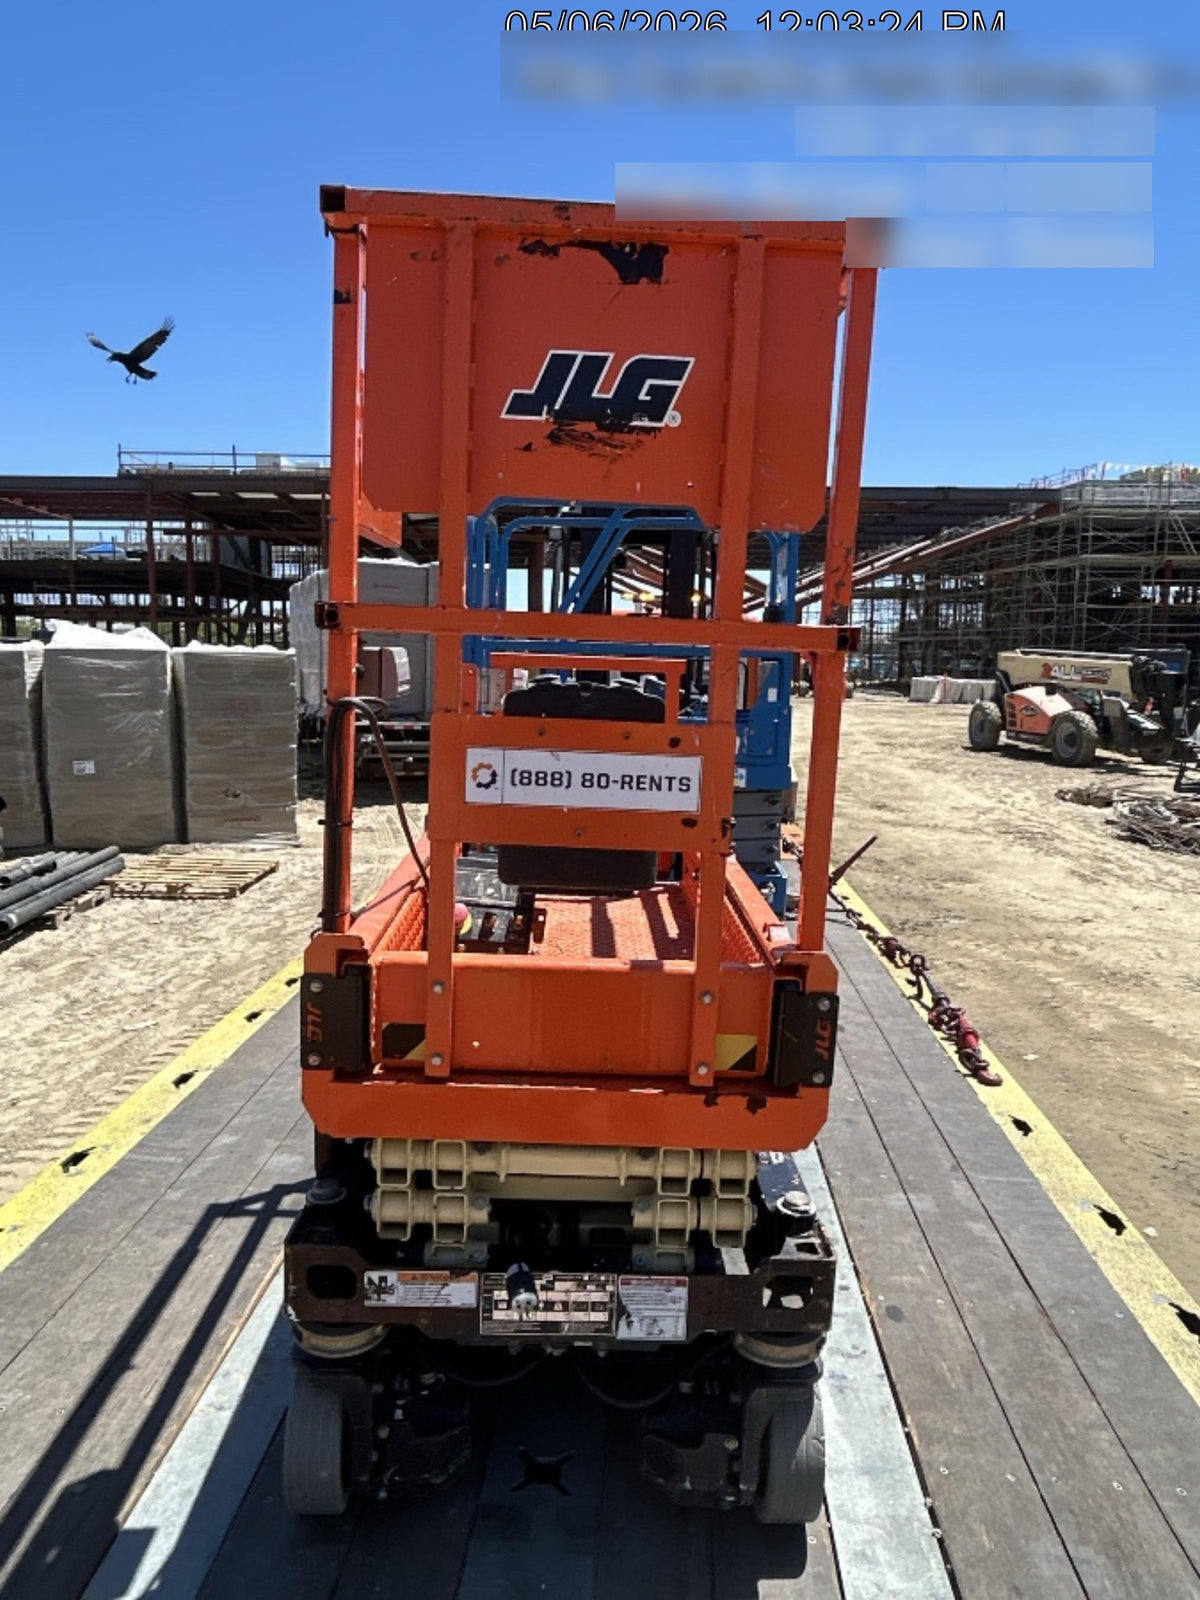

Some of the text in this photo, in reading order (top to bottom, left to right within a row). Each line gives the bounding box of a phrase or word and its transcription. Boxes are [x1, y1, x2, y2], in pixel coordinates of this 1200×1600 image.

[500, 350, 695, 428] JLG
[510, 767, 692, 793] (888) 80-RENTS
[306, 1001, 323, 1043] JLG
[815, 1018, 832, 1060] JLG
